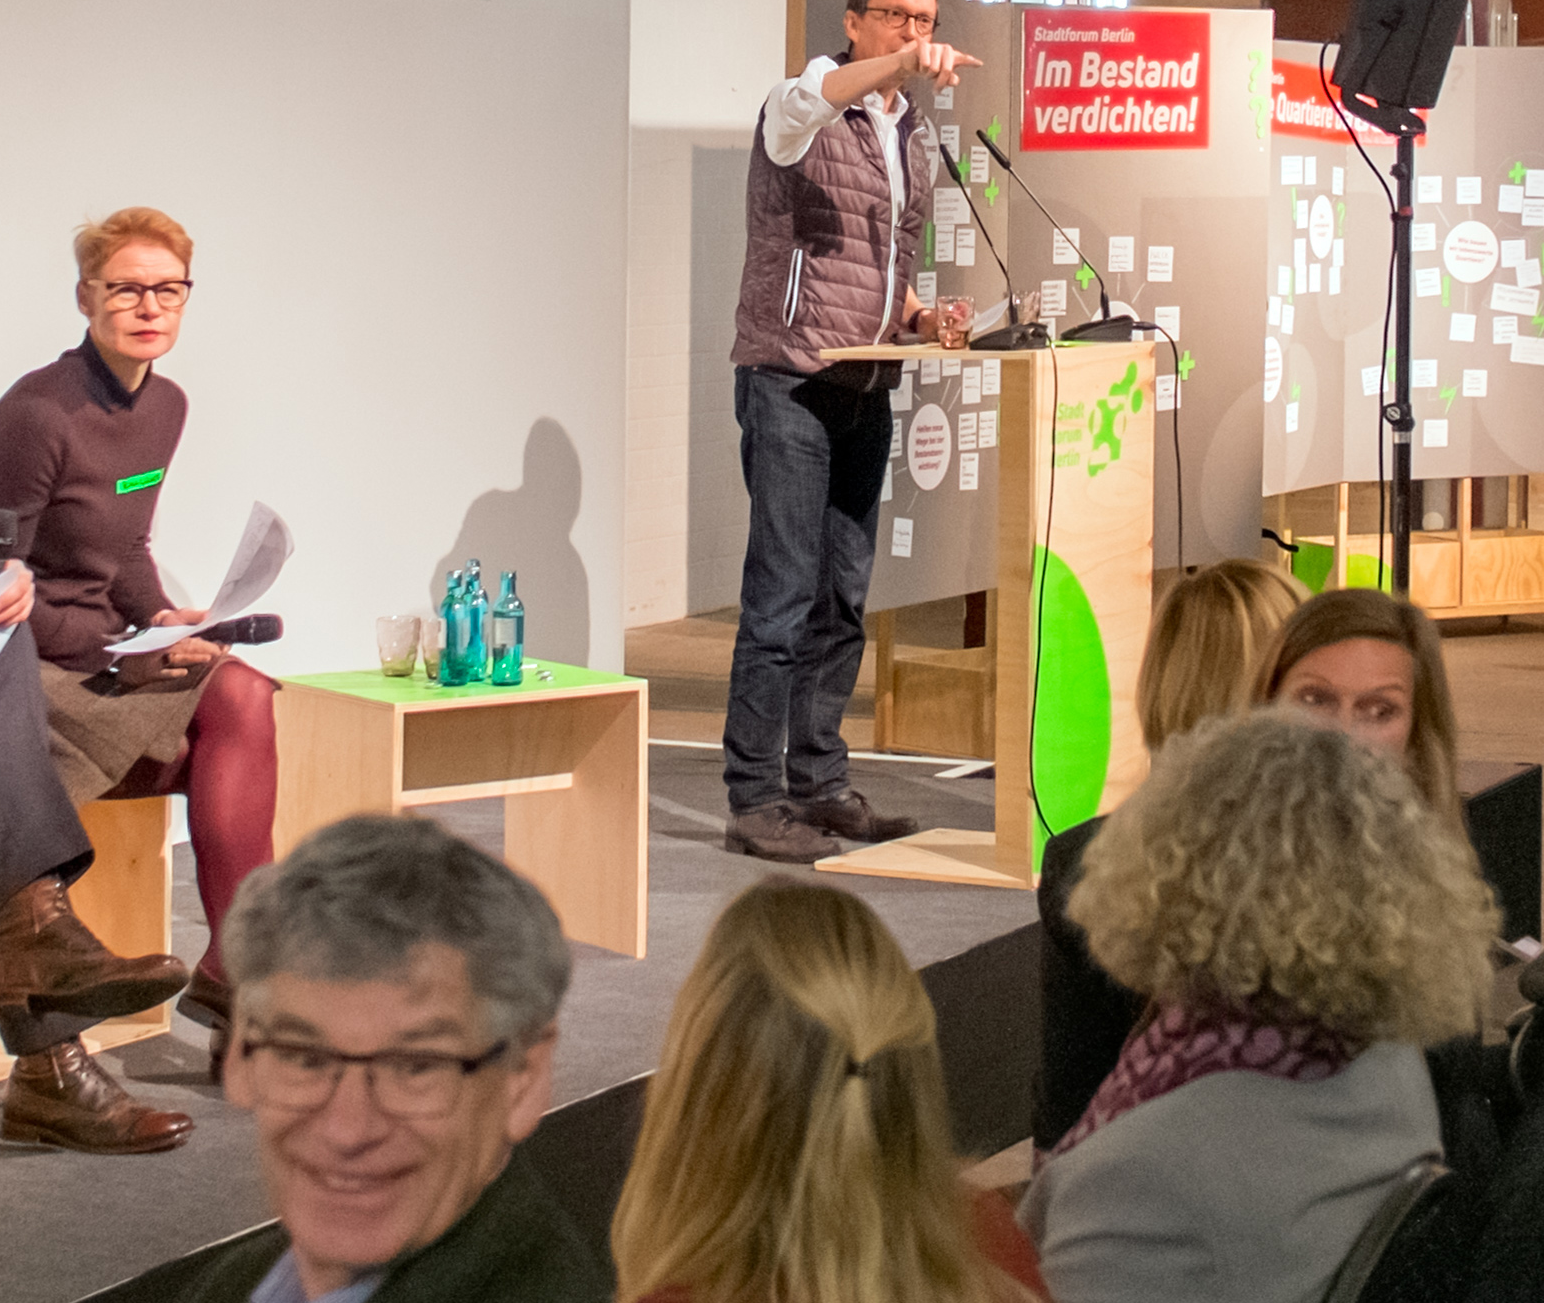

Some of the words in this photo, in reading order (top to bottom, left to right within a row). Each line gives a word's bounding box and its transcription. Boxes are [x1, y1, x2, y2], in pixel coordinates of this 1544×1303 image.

[1034, 26, 1099, 43] Stadtforum
[1100, 27, 1135, 43] Berlin
[1034, 51, 1072, 88] Im
[1079, 51, 1200, 89] Bestand
[1034, 95, 1199, 134] verdichten!
[1276, 91, 1333, 129] Quartiere
